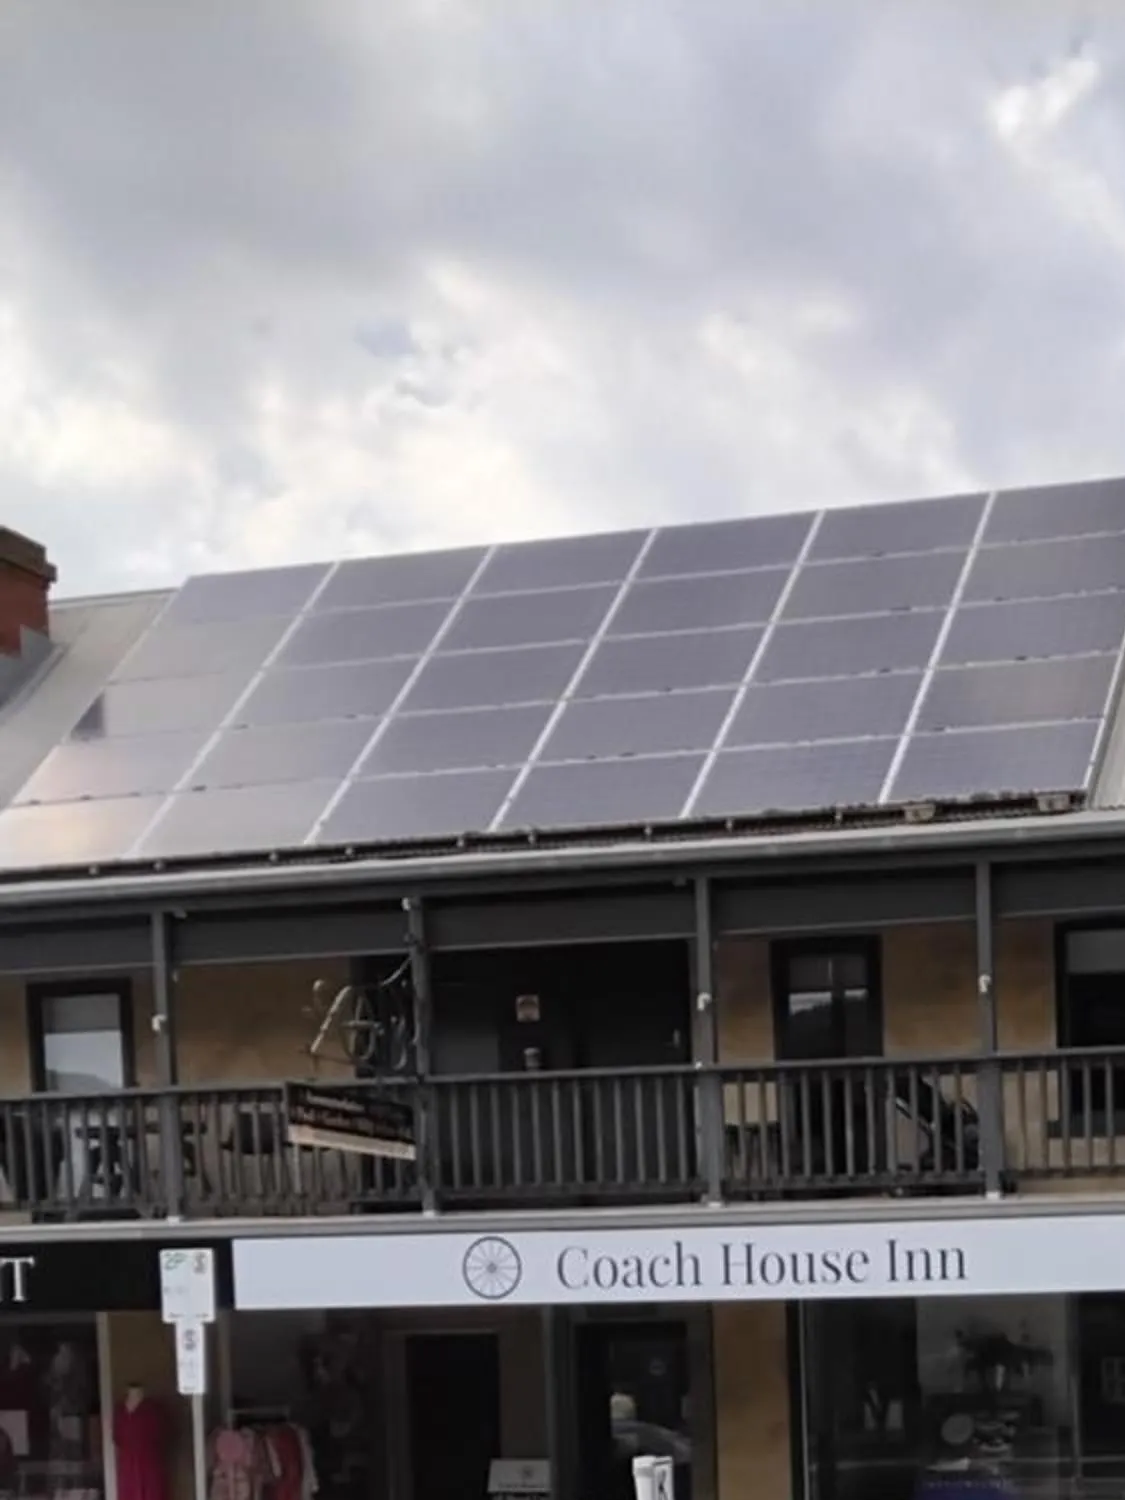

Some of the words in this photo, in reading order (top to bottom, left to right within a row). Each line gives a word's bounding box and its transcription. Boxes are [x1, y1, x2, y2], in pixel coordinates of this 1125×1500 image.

[556, 1240, 702, 1290] Coach
[720, 1242, 870, 1286] House
[887, 1237, 967, 1282] Inn
